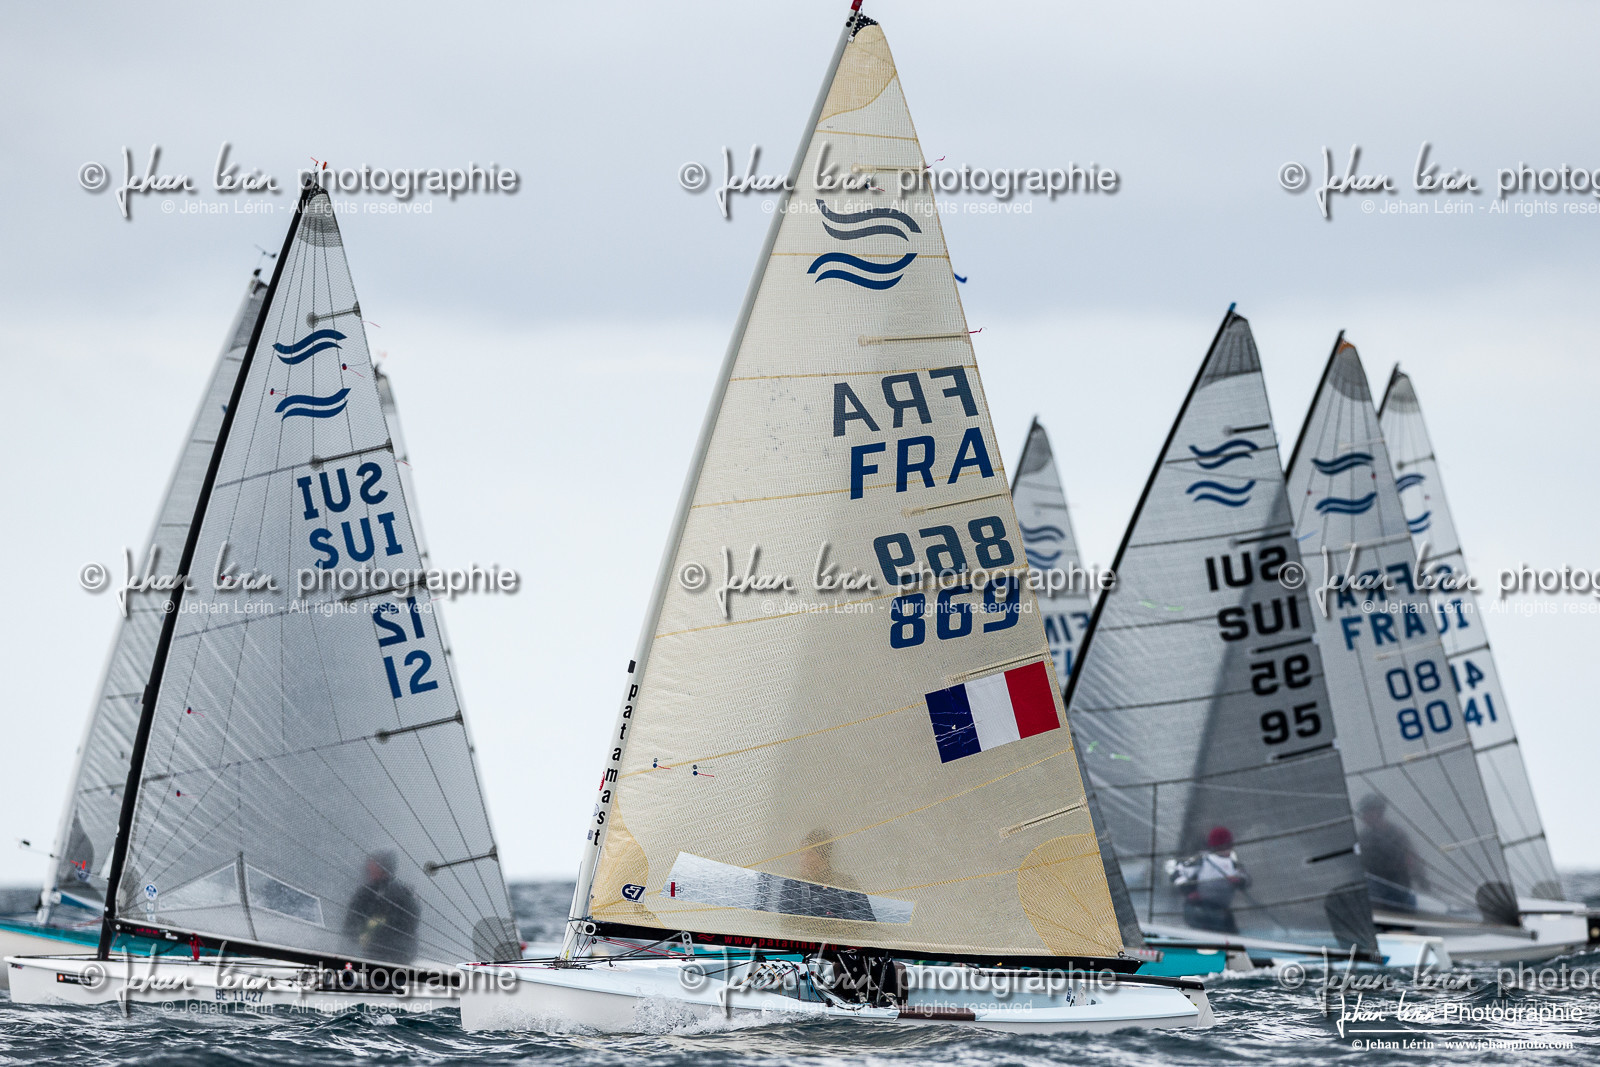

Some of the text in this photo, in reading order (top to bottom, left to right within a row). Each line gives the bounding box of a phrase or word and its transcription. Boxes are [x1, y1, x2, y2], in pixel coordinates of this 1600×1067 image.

[850, 426, 995, 500] FRA
[309, 511, 403, 570] SUI
[890, 576, 1020, 649] 869
[1217, 595, 1301, 642] SUI
[1340, 604, 1427, 650] FRA
[383, 650, 438, 699] 12
[1260, 702, 1321, 745] 95
[1397, 700, 1453, 740] 80
[1465, 692, 1497, 726] 41
[593, 684, 639, 846] patamast
[215, 989, 227, 1000] BE
